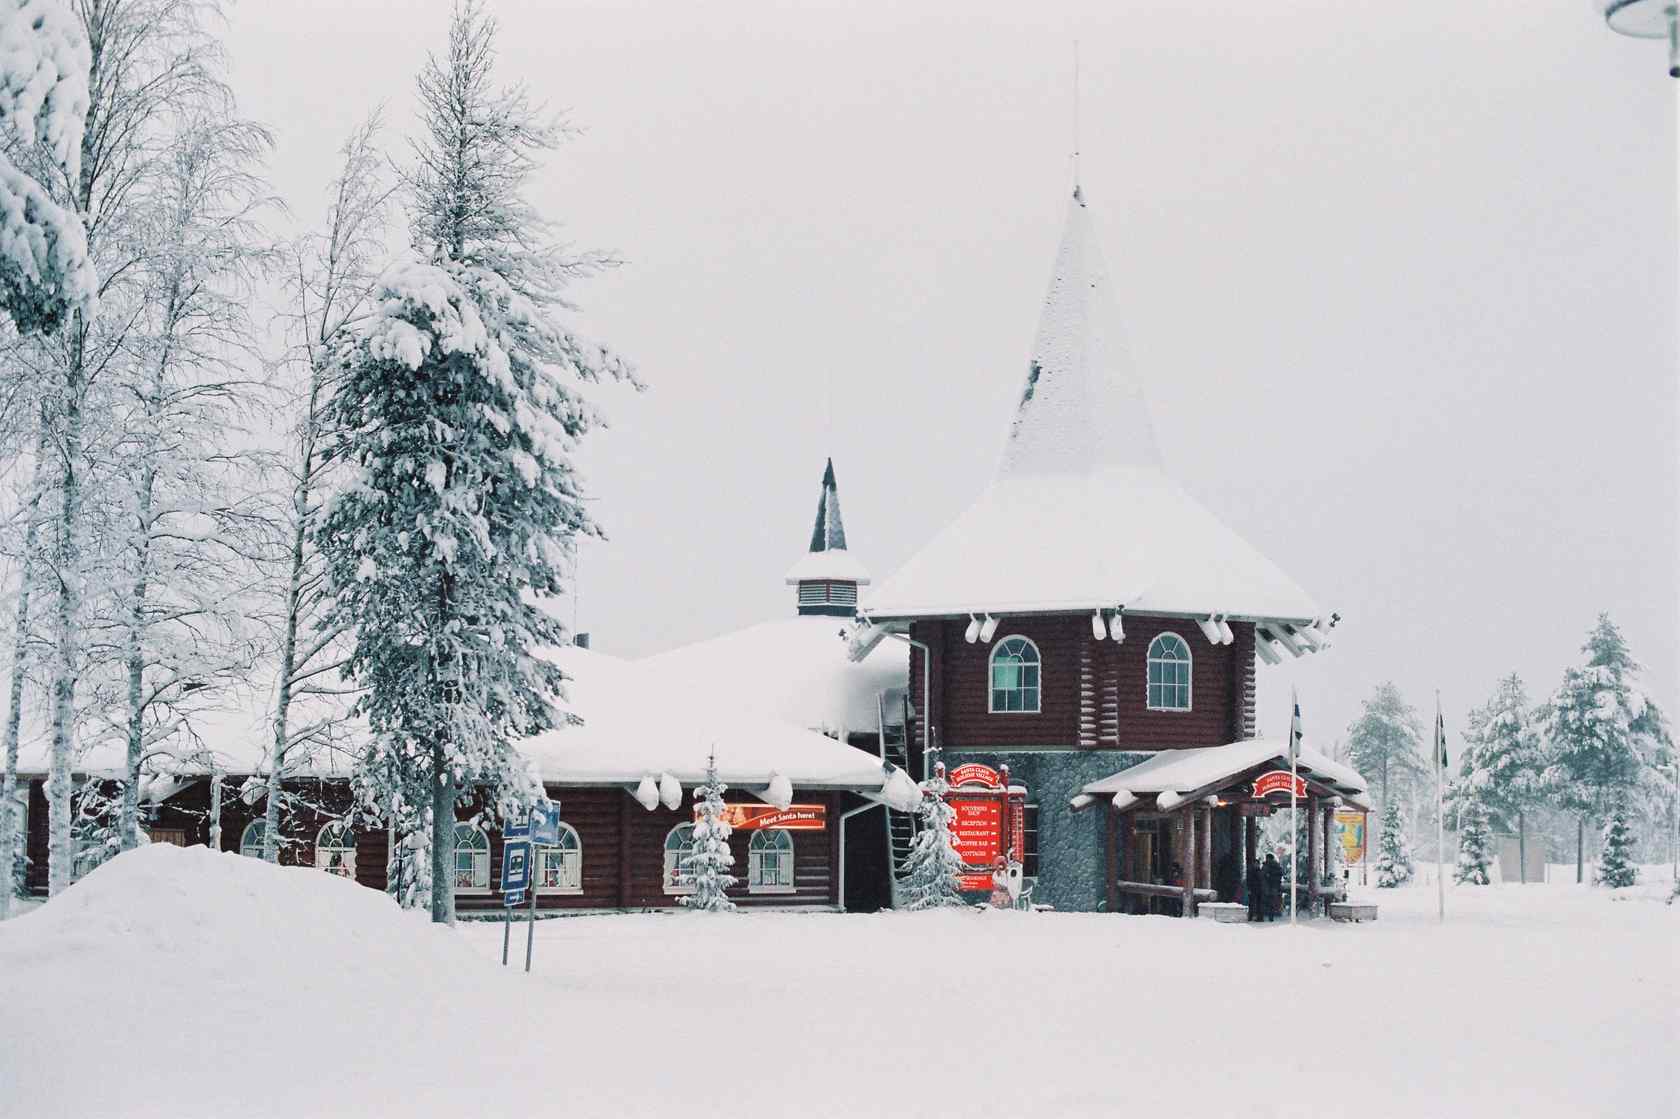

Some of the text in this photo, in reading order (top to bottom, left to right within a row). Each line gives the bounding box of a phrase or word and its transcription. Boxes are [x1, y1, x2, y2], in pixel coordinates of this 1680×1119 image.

[960, 767, 975, 775] SANTA
[760, 816, 777, 826] Meet
[778, 813, 797, 821] Santa
